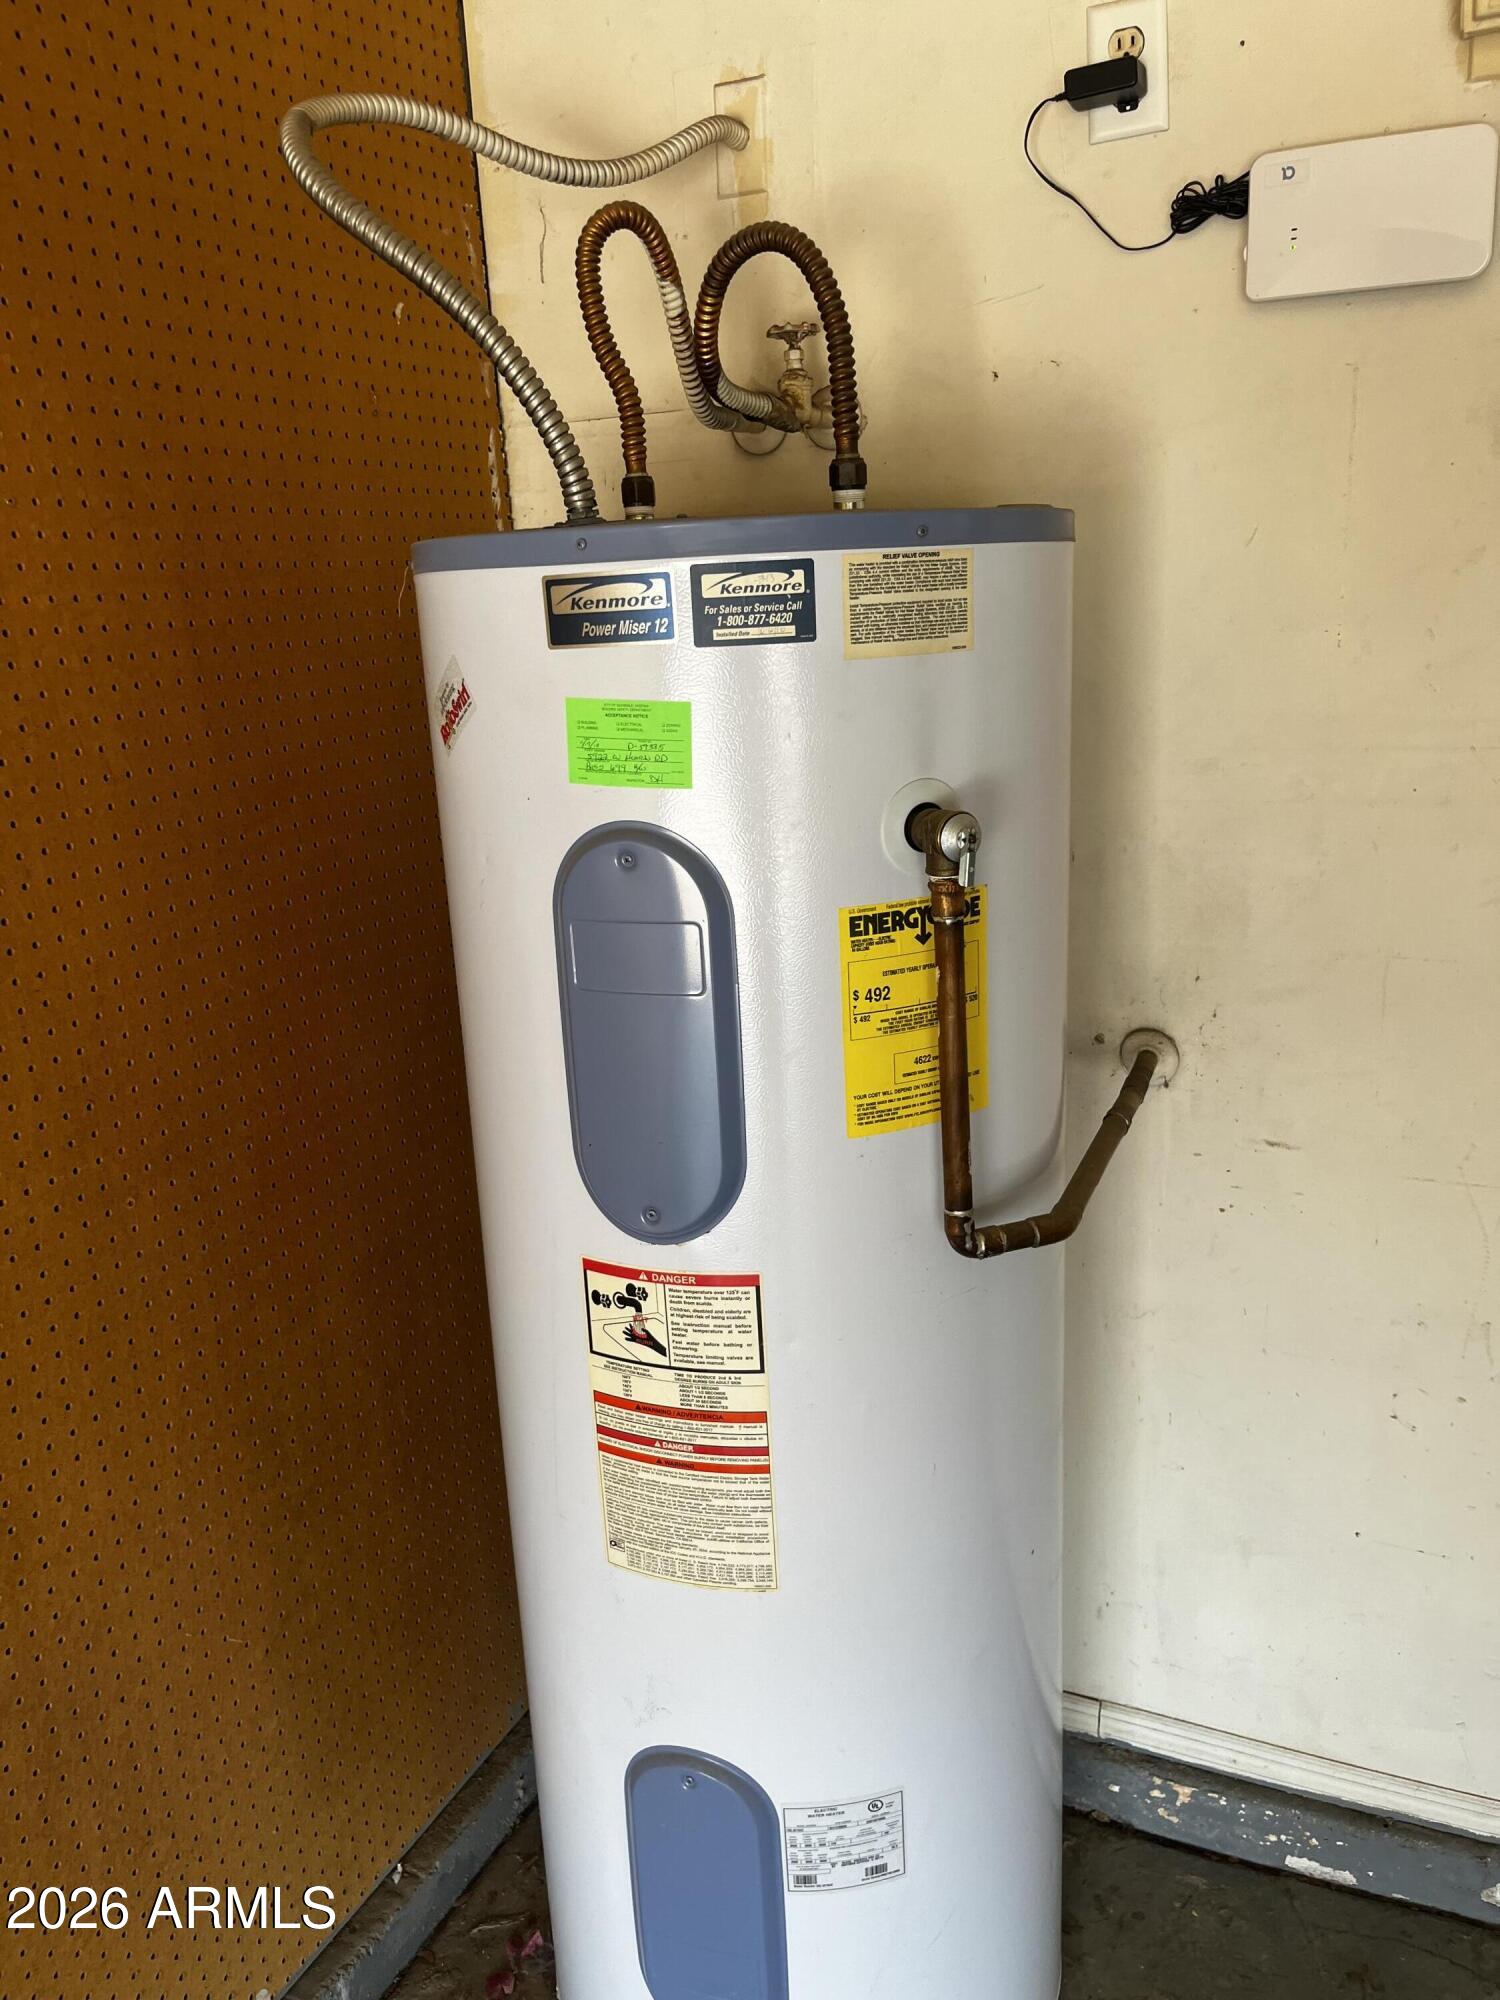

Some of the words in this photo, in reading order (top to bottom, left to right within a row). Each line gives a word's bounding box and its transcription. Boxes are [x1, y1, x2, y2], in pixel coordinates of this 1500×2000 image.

[720, 582, 802, 595] Kenmore
[570, 595, 663, 611] Kenmore
[704, 605, 718, 615] For
[719, 604, 742, 614] Sales
[754, 602, 784, 612] Service
[786, 600, 802, 611] Call
[717, 612, 793, 627] 1-800-877-6420
[582, 622, 616, 637] Power
[618, 620, 652, 635] Miser
[655, 617, 669, 633] 12
[849, 896, 980, 938] ENERGYE
[882, 968, 906, 976] ESTIMATED
[906, 965, 922, 973] YEARLY
[853, 990, 860, 1002] $
[864, 986, 890, 1002] 492
[860, 1015, 870, 1023] 492
[914, 1054, 932, 1065] 4622
[652, 1273, 696, 1285] DANGER
[642, 1406, 672, 1416] WARNING
[676, 1410, 724, 1420] ADVERTENCIA
[662, 1442, 694, 1452] DANGER
[664, 1460, 694, 1470] WARNING
